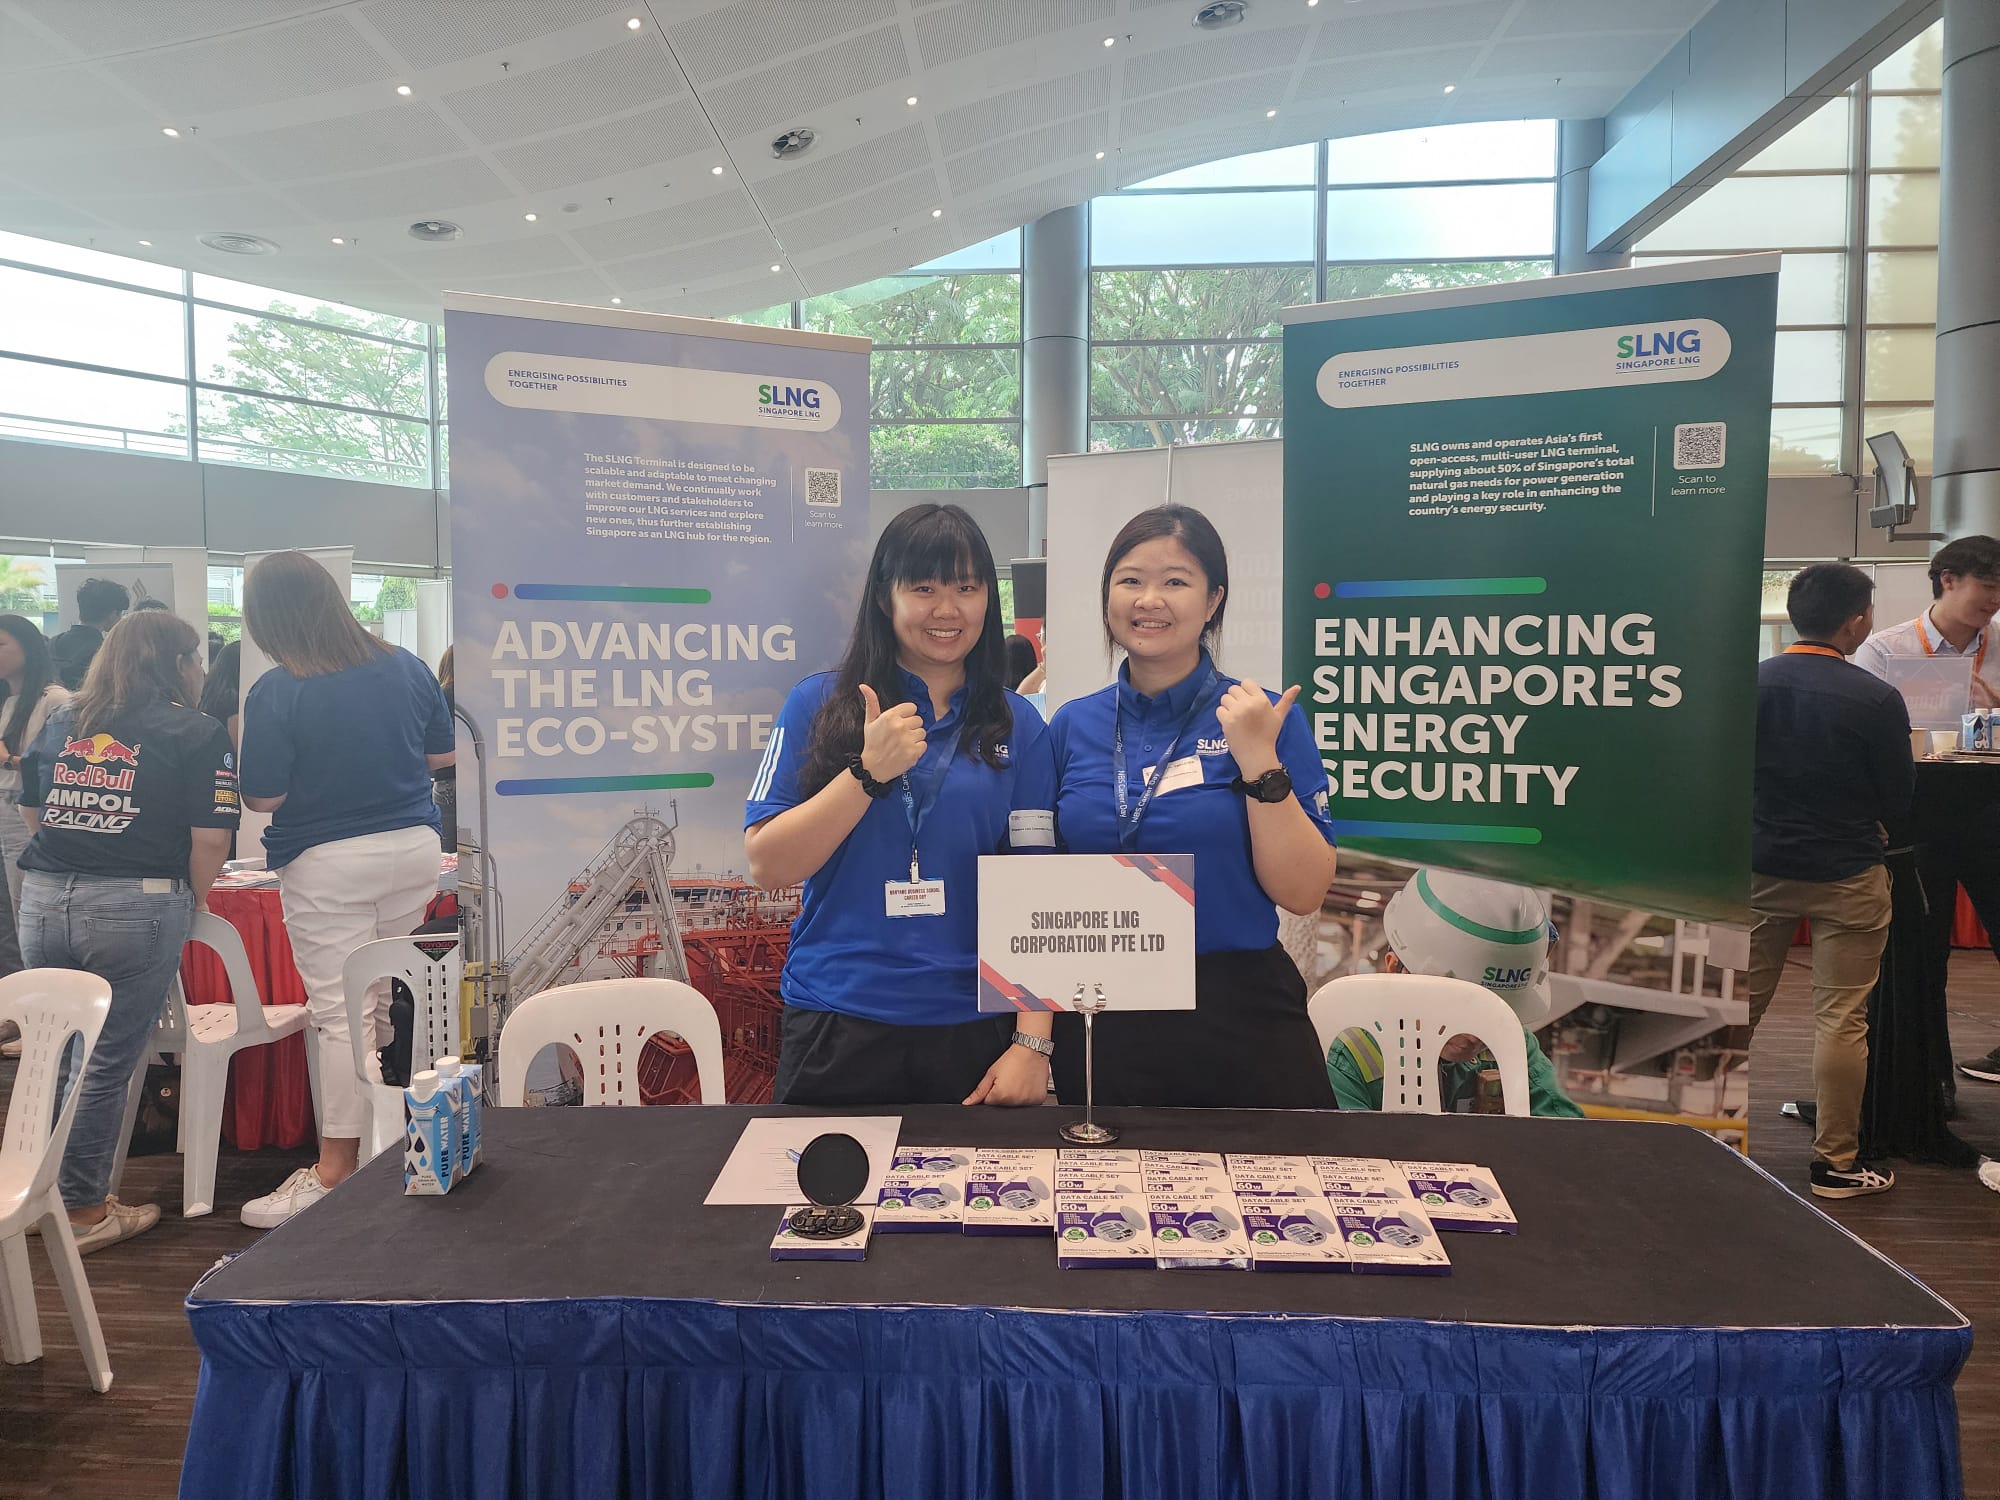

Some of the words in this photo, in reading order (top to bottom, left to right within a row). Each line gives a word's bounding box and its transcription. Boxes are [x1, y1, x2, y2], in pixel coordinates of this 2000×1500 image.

[1616, 329, 1701, 358] SLNG
[1338, 367, 1393, 378] ENERGISING
[1395, 361, 1460, 373] POSSIBILITIES
[1616, 358, 1676, 369] SINGAPORE
[1679, 356, 1700, 364] LNG
[508, 369, 564, 381] ENERGISING
[566, 375, 628, 386] POSSIBILITIES
[508, 380, 558, 391] TOGETHER
[1338, 378, 1387, 388] TOGETHER
[758, 385, 820, 408] SLNG
[758, 407, 803, 416] SINGAPORE
[1410, 443, 1439, 453] SLNG
[1441, 442, 1470, 450] owns
[1471, 439, 1493, 448] and
[1494, 436, 1543, 449] operates
[1578, 432, 1603, 442] first
[584, 453, 603, 462] The
[605, 455, 633, 464] SLNG
[634, 456, 677, 468] Terminal
[678, 459, 686, 469] is
[687, 461, 730, 471] designed
[732, 464, 741, 472] to
[744, 464, 755, 472] be
[1410, 455, 1479, 466] open-access,
[1481, 451, 1539, 461] multi-user
[1541, 448, 1566, 458] LNG
[1567, 443, 1620, 455] terminal,
[585, 467, 625, 476] scalable
[627, 469, 645, 477] and
[647, 470, 694, 480] adaptable
[709, 475, 732, 483] meet
[734, 476, 777, 487] changing
[1409, 467, 1461, 479] supplying
[1463, 465, 1496, 475] about
[1497, 463, 1521, 472] 50%
[1523, 462, 1536, 472] of
[1605, 456, 1634, 466] total
[585, 479, 623, 488] market
[623, 480, 665, 491] demand.
[666, 483, 681, 491] We
[683, 485, 736, 496] continually
[738, 488, 762, 496] work
[1409, 480, 1448, 490] natural
[1449, 481, 1468, 490] gas
[1470, 478, 1502, 487] needs
[1504, 477, 1520, 486] for
[1522, 476, 1559, 487] power
[1560, 471, 1624, 484] generation
[585, 491, 608, 499] with
[610, 492, 660, 502] customers
[662, 495, 680, 504] and
[681, 497, 742, 507] stakeholders
[1409, 494, 1429, 503] and
[1431, 493, 1471, 504] playing
[1481, 491, 1500, 501] key
[1502, 490, 1524, 499] role
[1526, 489, 1537, 497] in
[1539, 486, 1599, 496] enhancing
[1601, 484, 1621, 493] the
[585, 502, 627, 513] improve
[648, 506, 669, 515] LNG
[669, 508, 708, 517] services
[709, 510, 727, 518] and
[729, 511, 764, 520] explore
[1460, 505, 1498, 514] energy
[1499, 502, 1546, 512] security.
[608, 517, 635, 526] ones,
[637, 518, 659, 526] thus
[660, 518, 693, 528] further
[695, 521, 752, 532] establishing
[586, 526, 637, 538] Singapore
[664, 530, 685, 539] LNG
[686, 532, 705, 540] hub
[707, 533, 720, 541] for
[723, 533, 738, 541] the
[740, 535, 772, 544] region.
[491, 621, 797, 661] ADVANCING
[1315, 613, 1655, 656] ENHANCING
[491, 669, 598, 708] THE
[612, 669, 713, 706] LNG
[1311, 665, 1683, 708] SINGAPORE'S
[496, 714, 774, 757] ECO-SYSTE
[1315, 712, 1529, 755] ENERGY
[1197, 739, 1229, 749] SLNG
[1117, 770, 1126, 783] NBS
[1321, 758, 1580, 806] SECURITY
[44, 788, 141, 814] AMPOL
[1118, 784, 1126, 804] Career
[1131, 808, 1142, 823] NBS
[1138, 787, 1153, 807] Career
[1150, 773, 1160, 785] Day
[43, 808, 134, 829] RACING
[1119, 804, 1128, 818] Day
[1031, 911, 1109, 929] SINGAPORE
[1113, 910, 1140, 928] LNG
[1010, 934, 1106, 954] CORPORATION
[1111, 934, 1136, 952] PTE
[1140, 934, 1165, 951] LTD
[1482, 967, 1532, 982] SLNG
